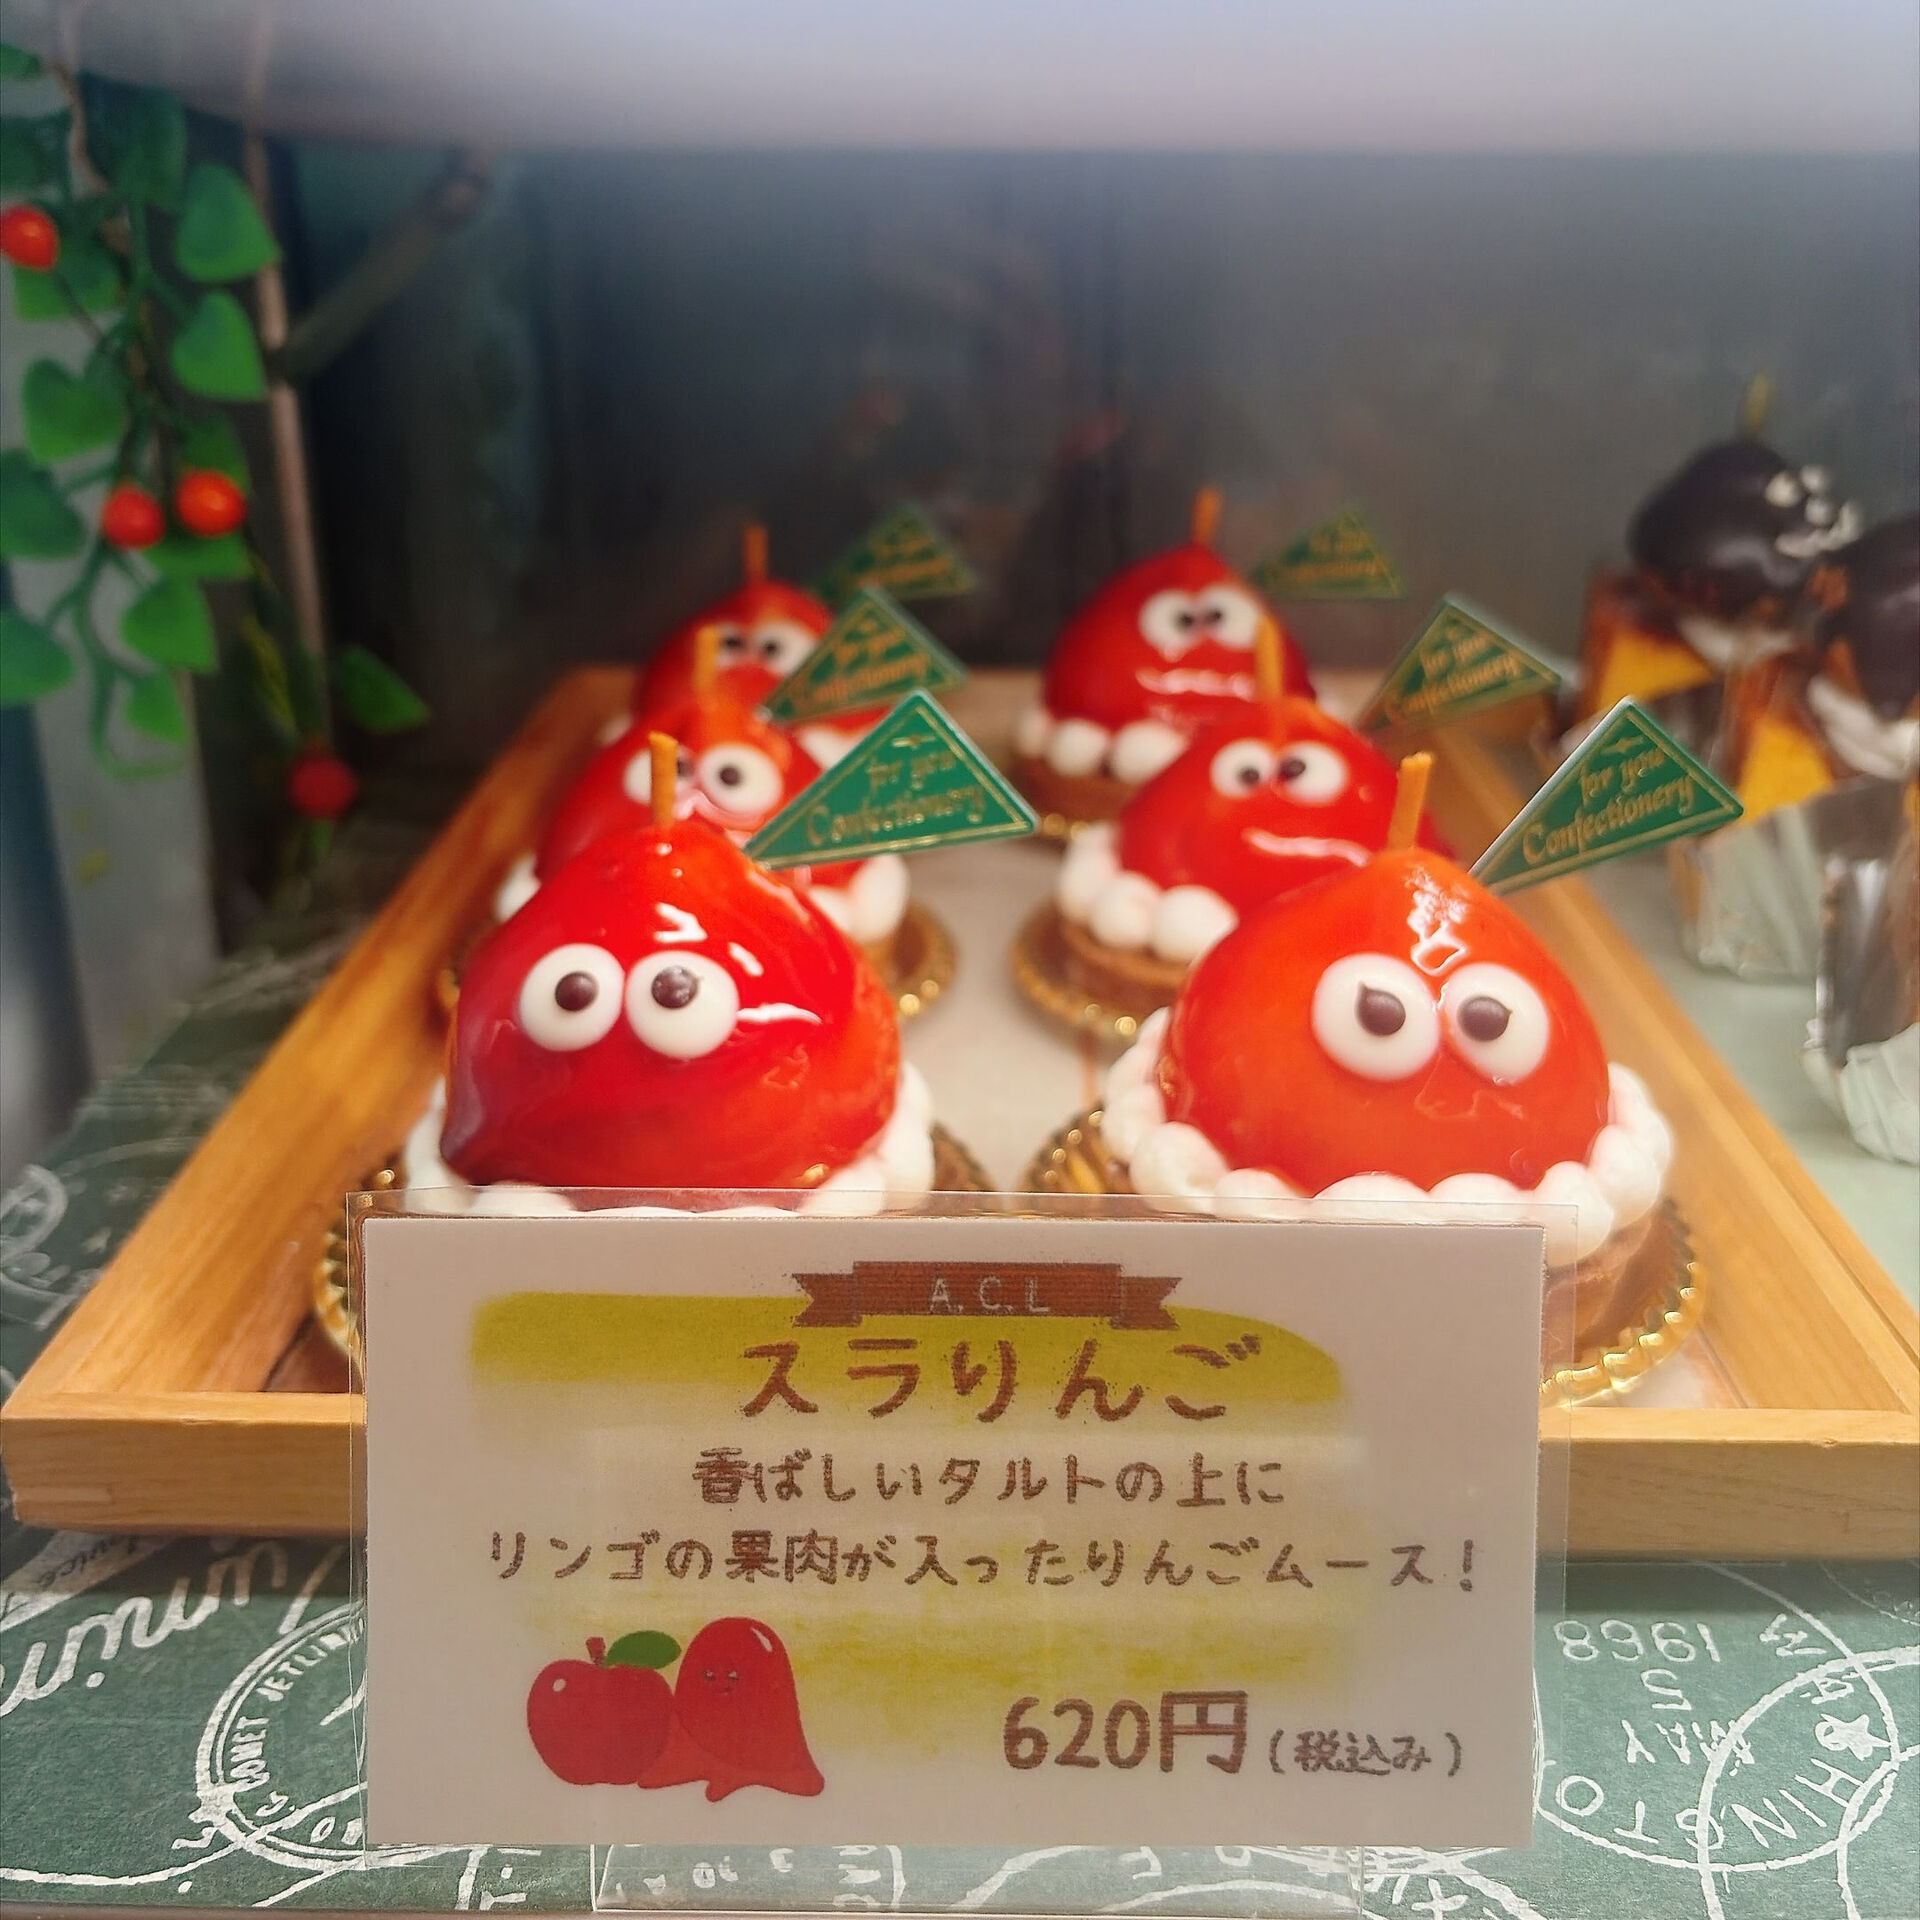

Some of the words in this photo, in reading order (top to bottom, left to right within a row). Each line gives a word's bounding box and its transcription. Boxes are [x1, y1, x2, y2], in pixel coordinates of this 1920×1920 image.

[1580, 766, 1613, 805] for
[1619, 748, 1667, 791] you
[1522, 773, 1696, 865] Confectionery
[740, 1335, 1261, 1422] スラりんご
[693, 1447, 1284, 1507] 香ばしいタルトの上に
[492, 1529, 1474, 1592] リンゴの果肉が入ったりんごムース!
[1554, 1620, 1721, 1662] 1968
[1003, 1690, 1248, 1773] 620円
[1269, 1728, 1461, 1777] (税込み)
